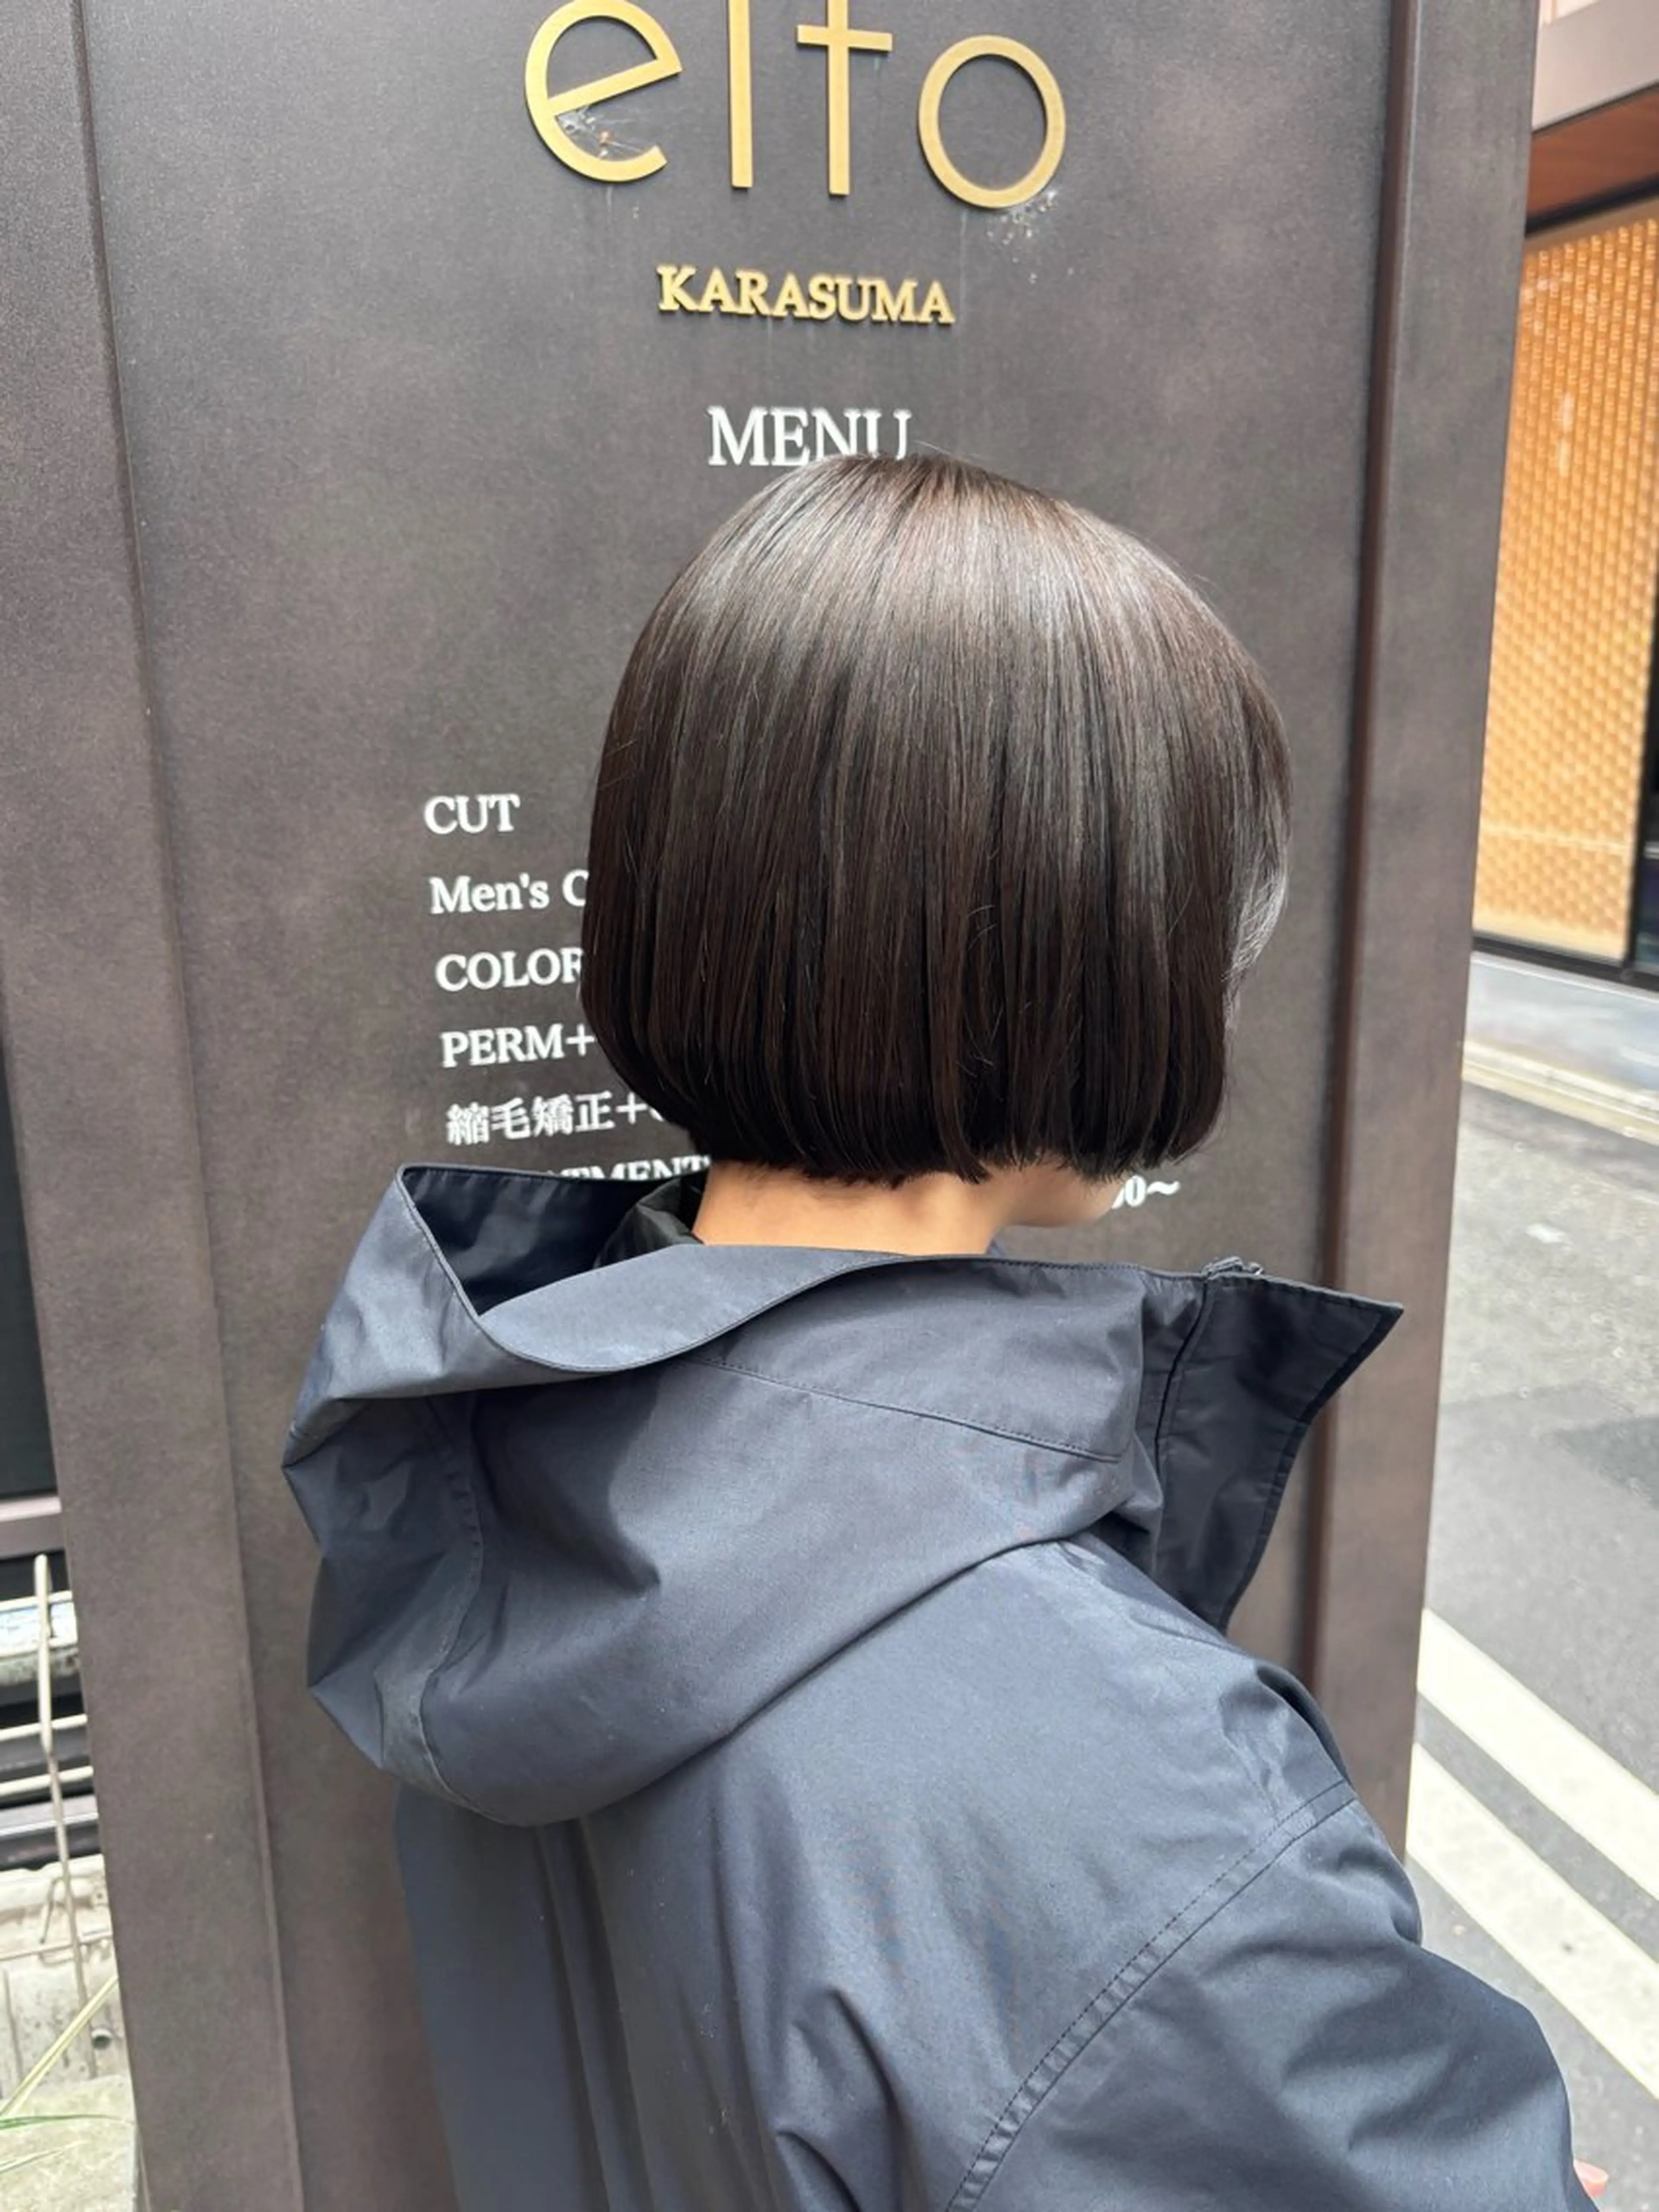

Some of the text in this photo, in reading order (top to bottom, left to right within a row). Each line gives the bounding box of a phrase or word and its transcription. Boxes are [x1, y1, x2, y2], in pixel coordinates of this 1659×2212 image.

[525, 0, 1066, 208] elto
[656, 265, 955, 324] KARASUMA
[707, 405, 912, 466] MENU
[423, 794, 521, 835] CUT
[429, 872, 550, 914] Men's
[440, 1023, 595, 1068] PERM+
[446, 1090, 664, 1146] 縮毛矯正+
